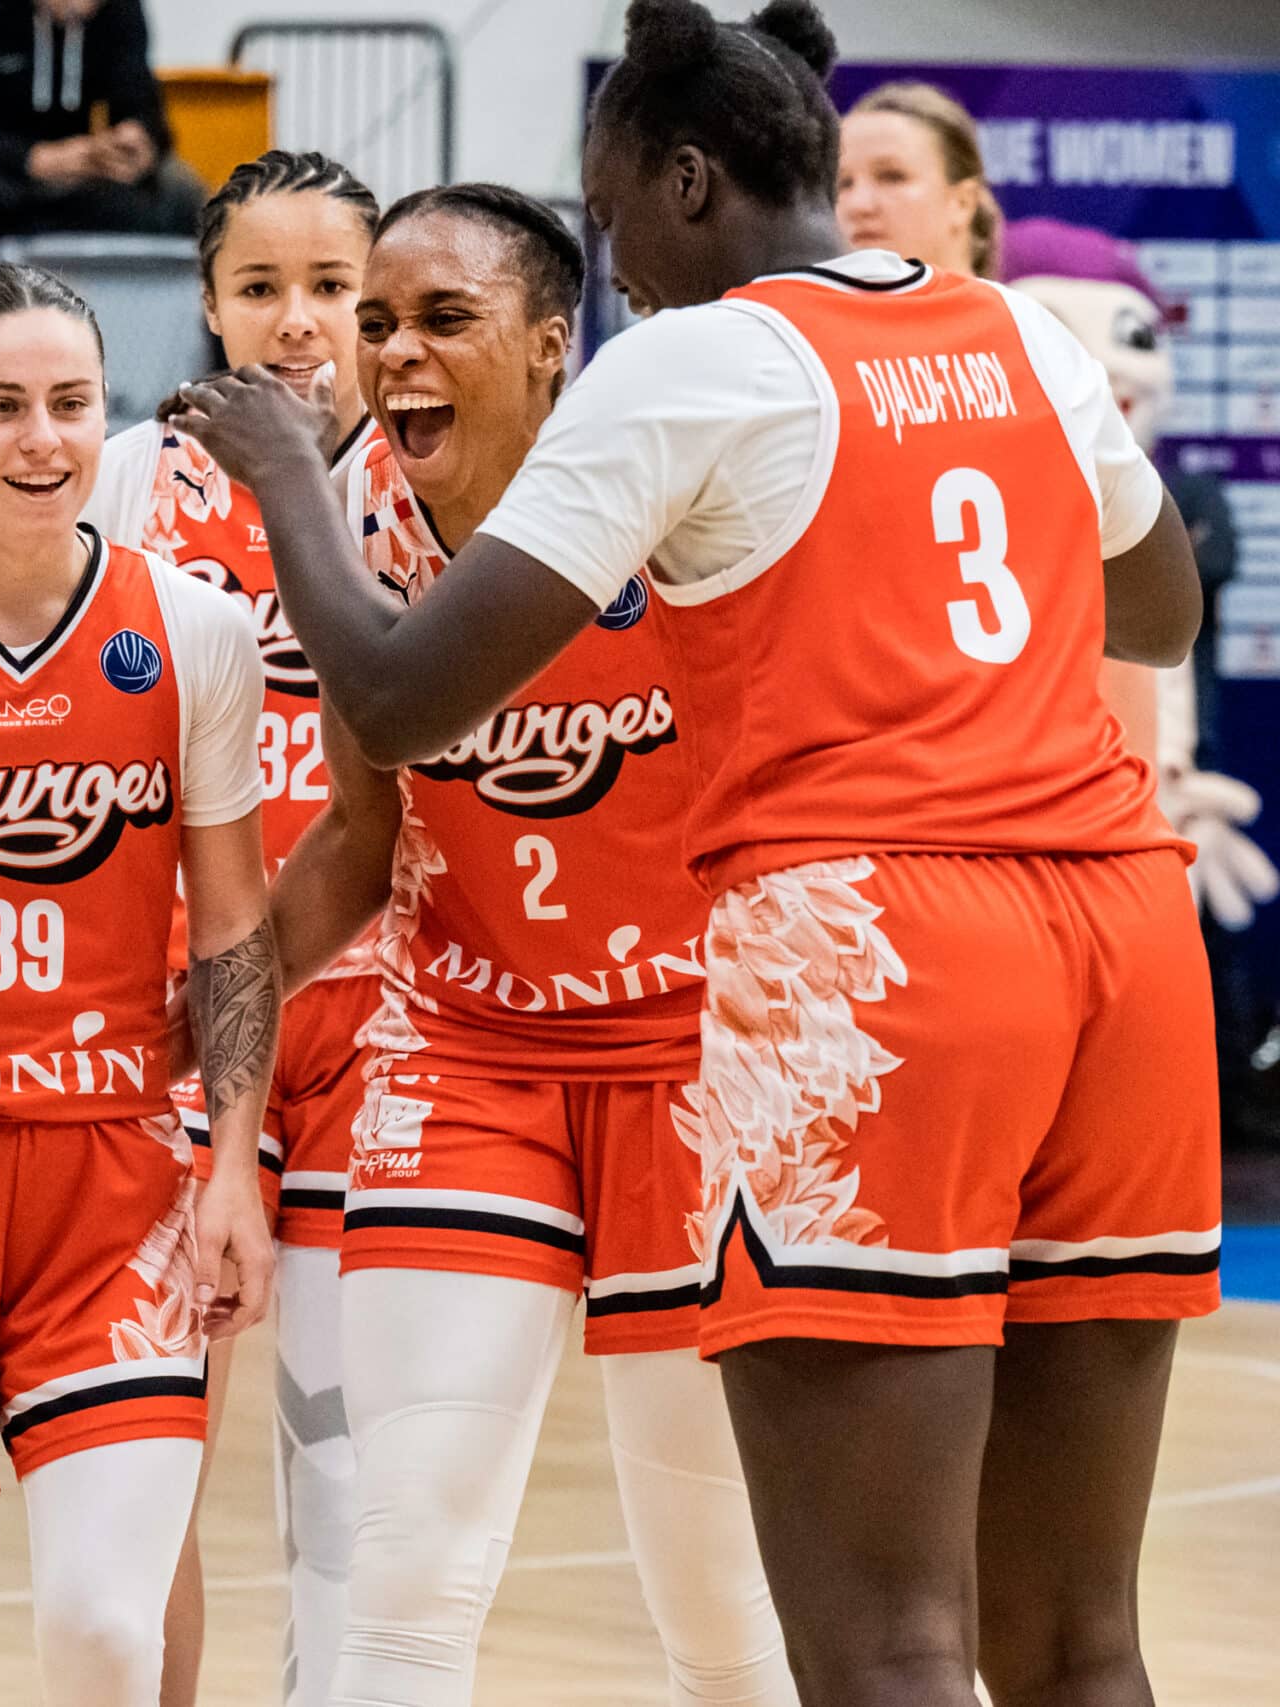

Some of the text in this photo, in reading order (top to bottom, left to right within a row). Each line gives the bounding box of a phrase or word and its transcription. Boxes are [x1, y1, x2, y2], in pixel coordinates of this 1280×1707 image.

[1049, 120, 1234, 188] WOMEN
[931, 467, 1031, 664] 3
[256, 712, 329, 800] 32
[410, 685, 678, 819] urges
[514, 835, 568, 920] 2
[365, 1151, 423, 1172] PHM
[386, 1170, 421, 1178] GROUP
